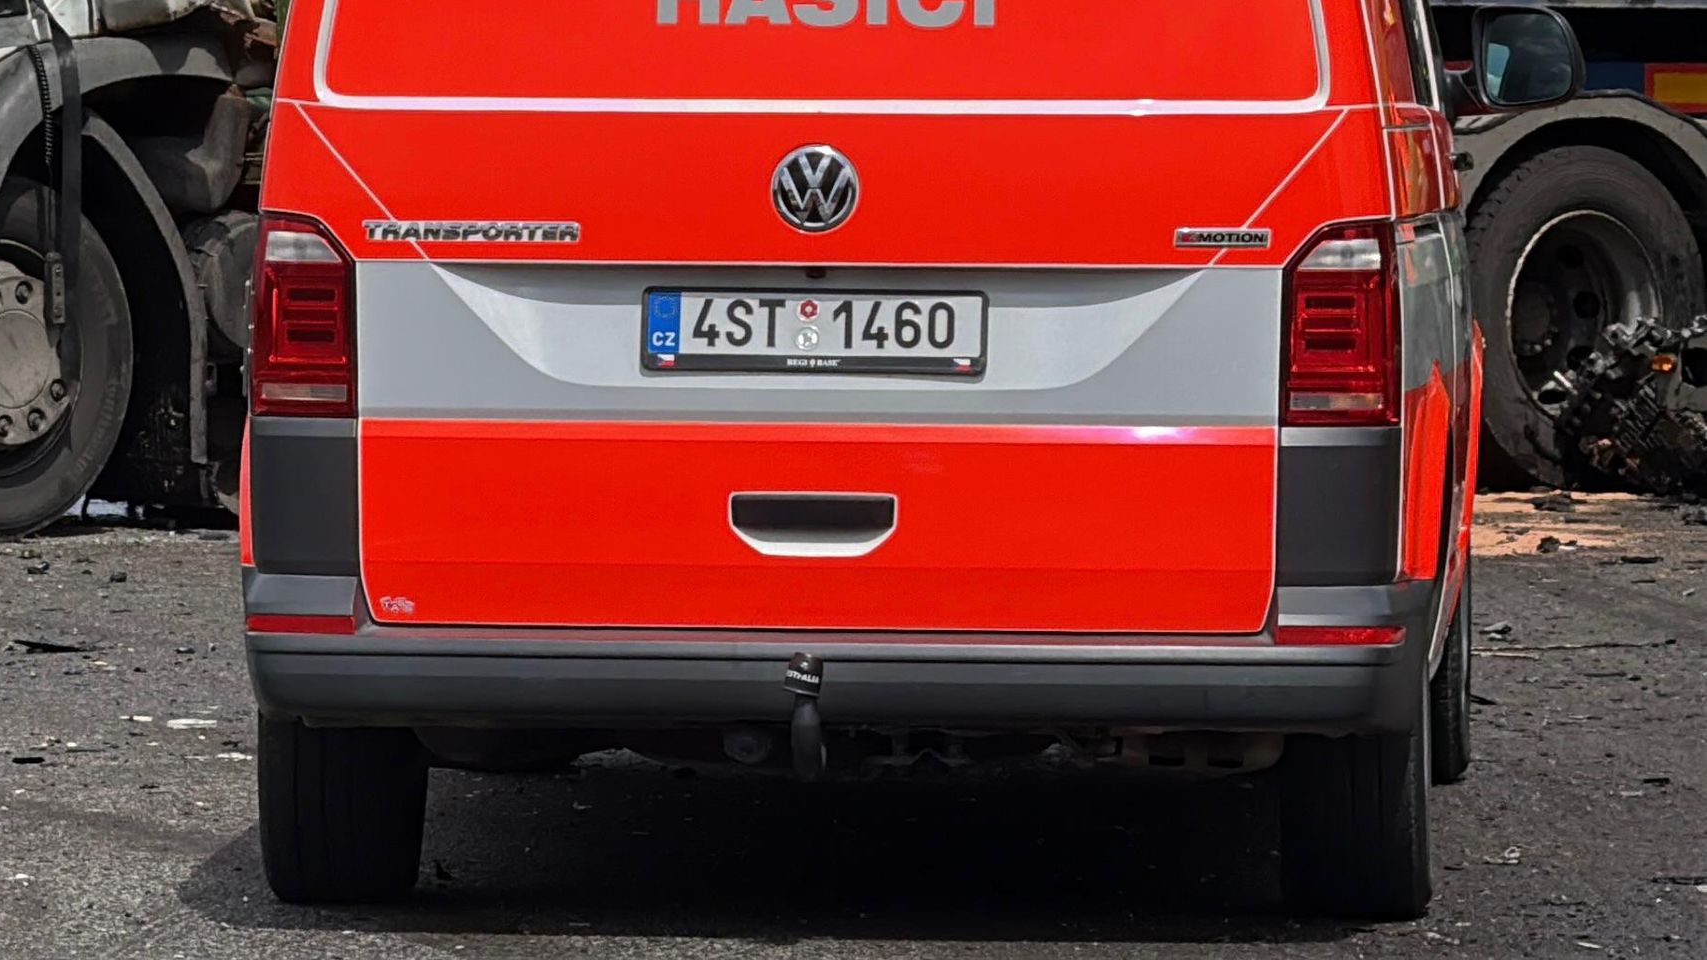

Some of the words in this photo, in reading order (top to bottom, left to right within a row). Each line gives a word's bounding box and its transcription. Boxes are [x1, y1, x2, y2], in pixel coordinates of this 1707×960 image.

[364, 221, 580, 241] TRANSPORTER
[692, 298, 786, 348] 4ST
[832, 300, 955, 350] 1460
[652, 331, 676, 347] CZ
